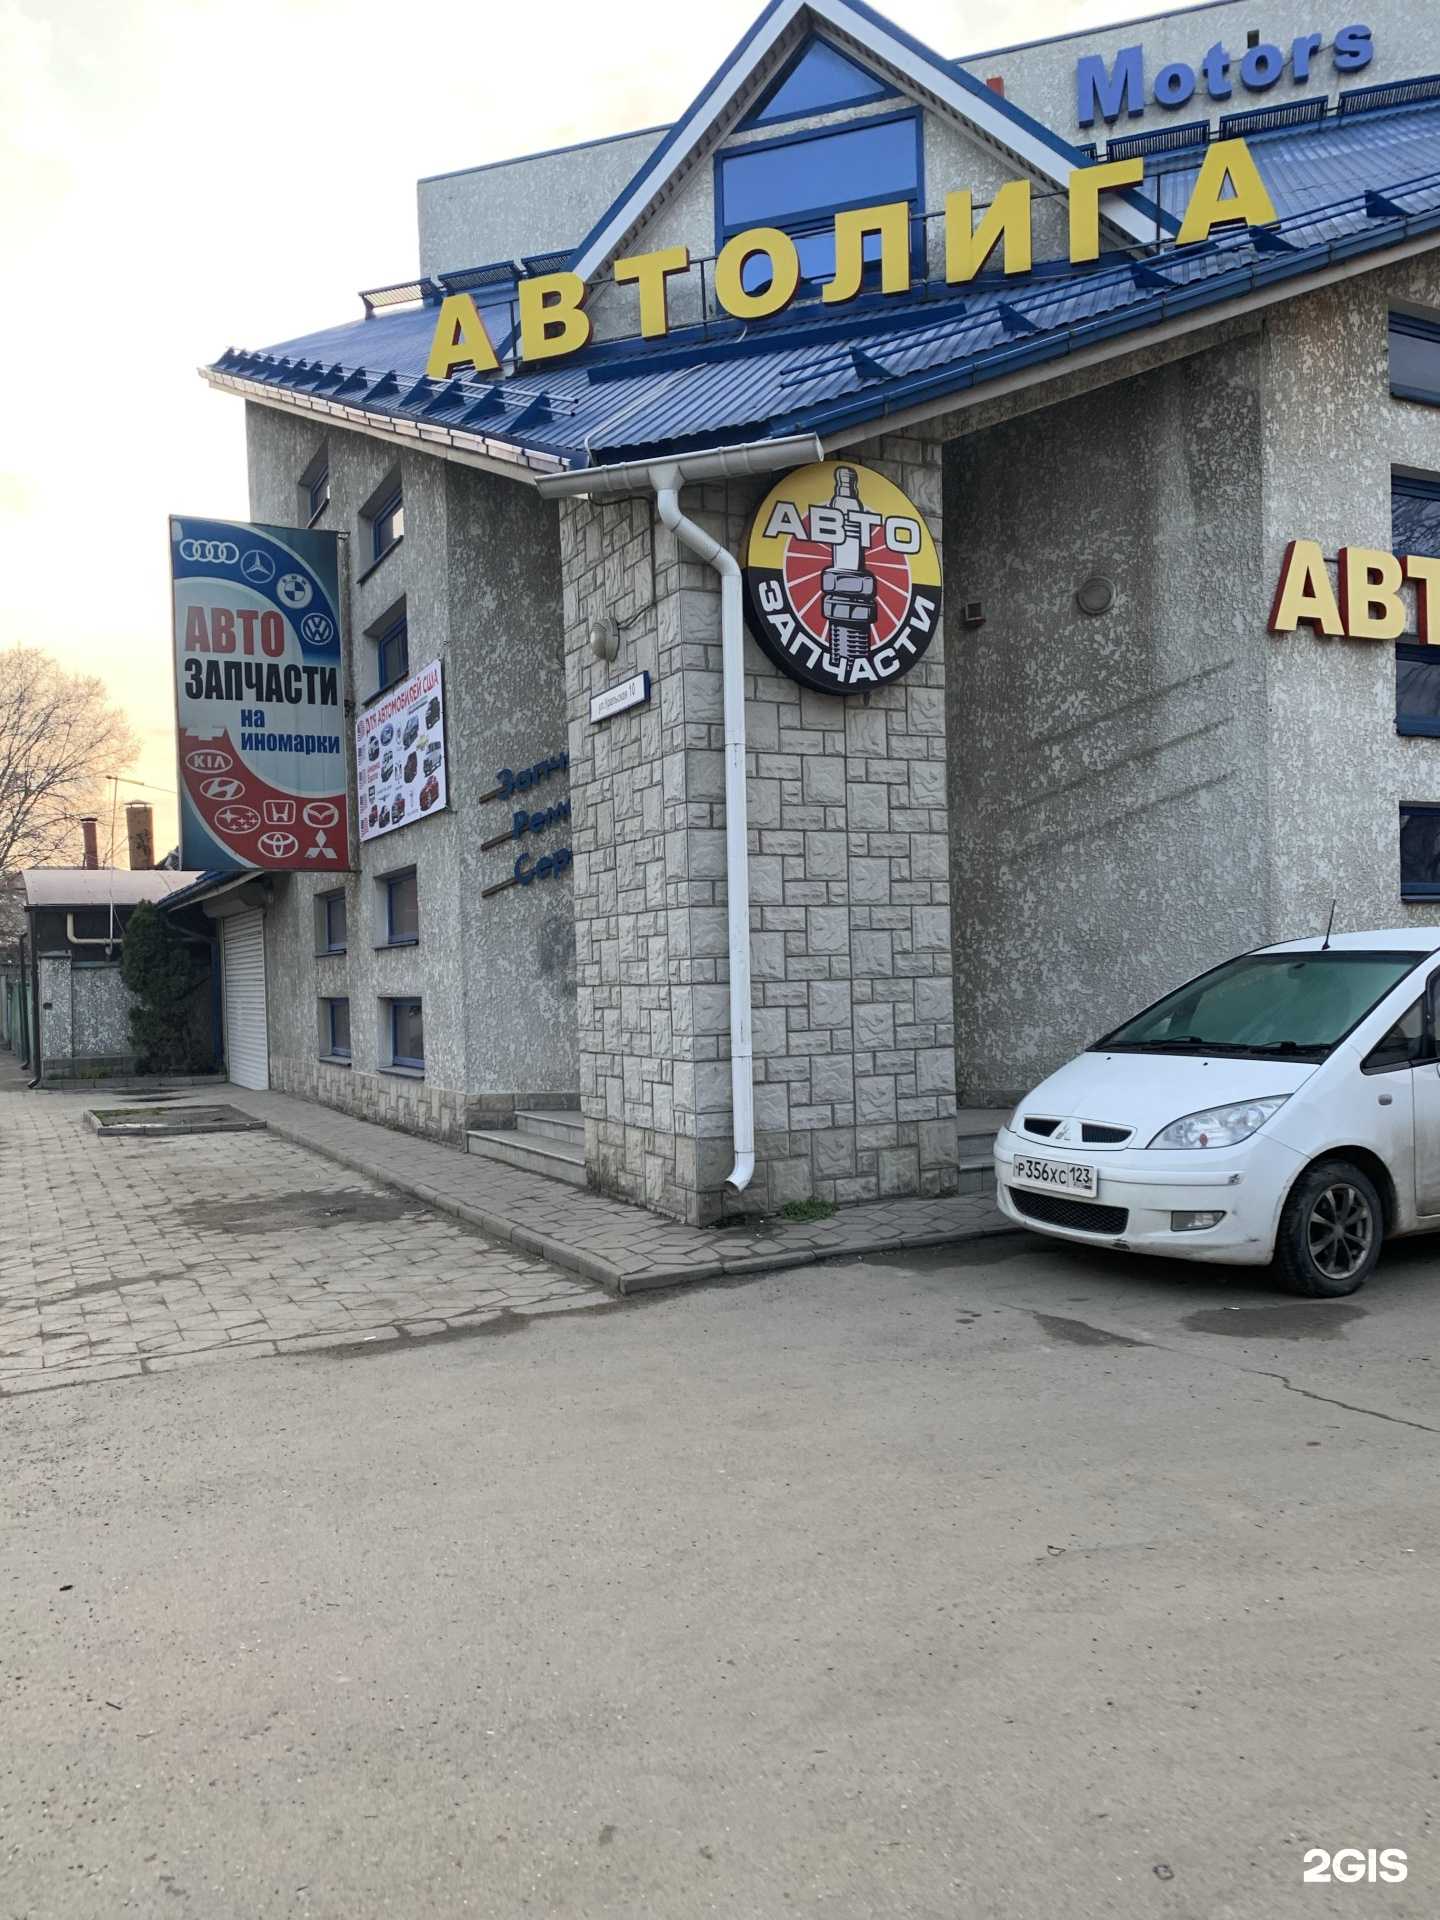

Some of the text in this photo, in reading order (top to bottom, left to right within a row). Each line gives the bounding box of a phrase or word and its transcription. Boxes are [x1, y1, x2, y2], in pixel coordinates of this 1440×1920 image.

[1077, 24, 1373, 128] Motors
[427, 138, 1279, 379] АВТОЛИГА
[763, 500, 921, 554] АВТО
[185, 606, 285, 657] АВТО
[758, 580, 935, 683] ЗАПЧАСТИ
[184, 658, 338, 706] ЗАПЧАСТИ
[240, 709, 266, 728] на
[240, 732, 340, 755] иномарки
[194, 755, 225, 768] KIA
